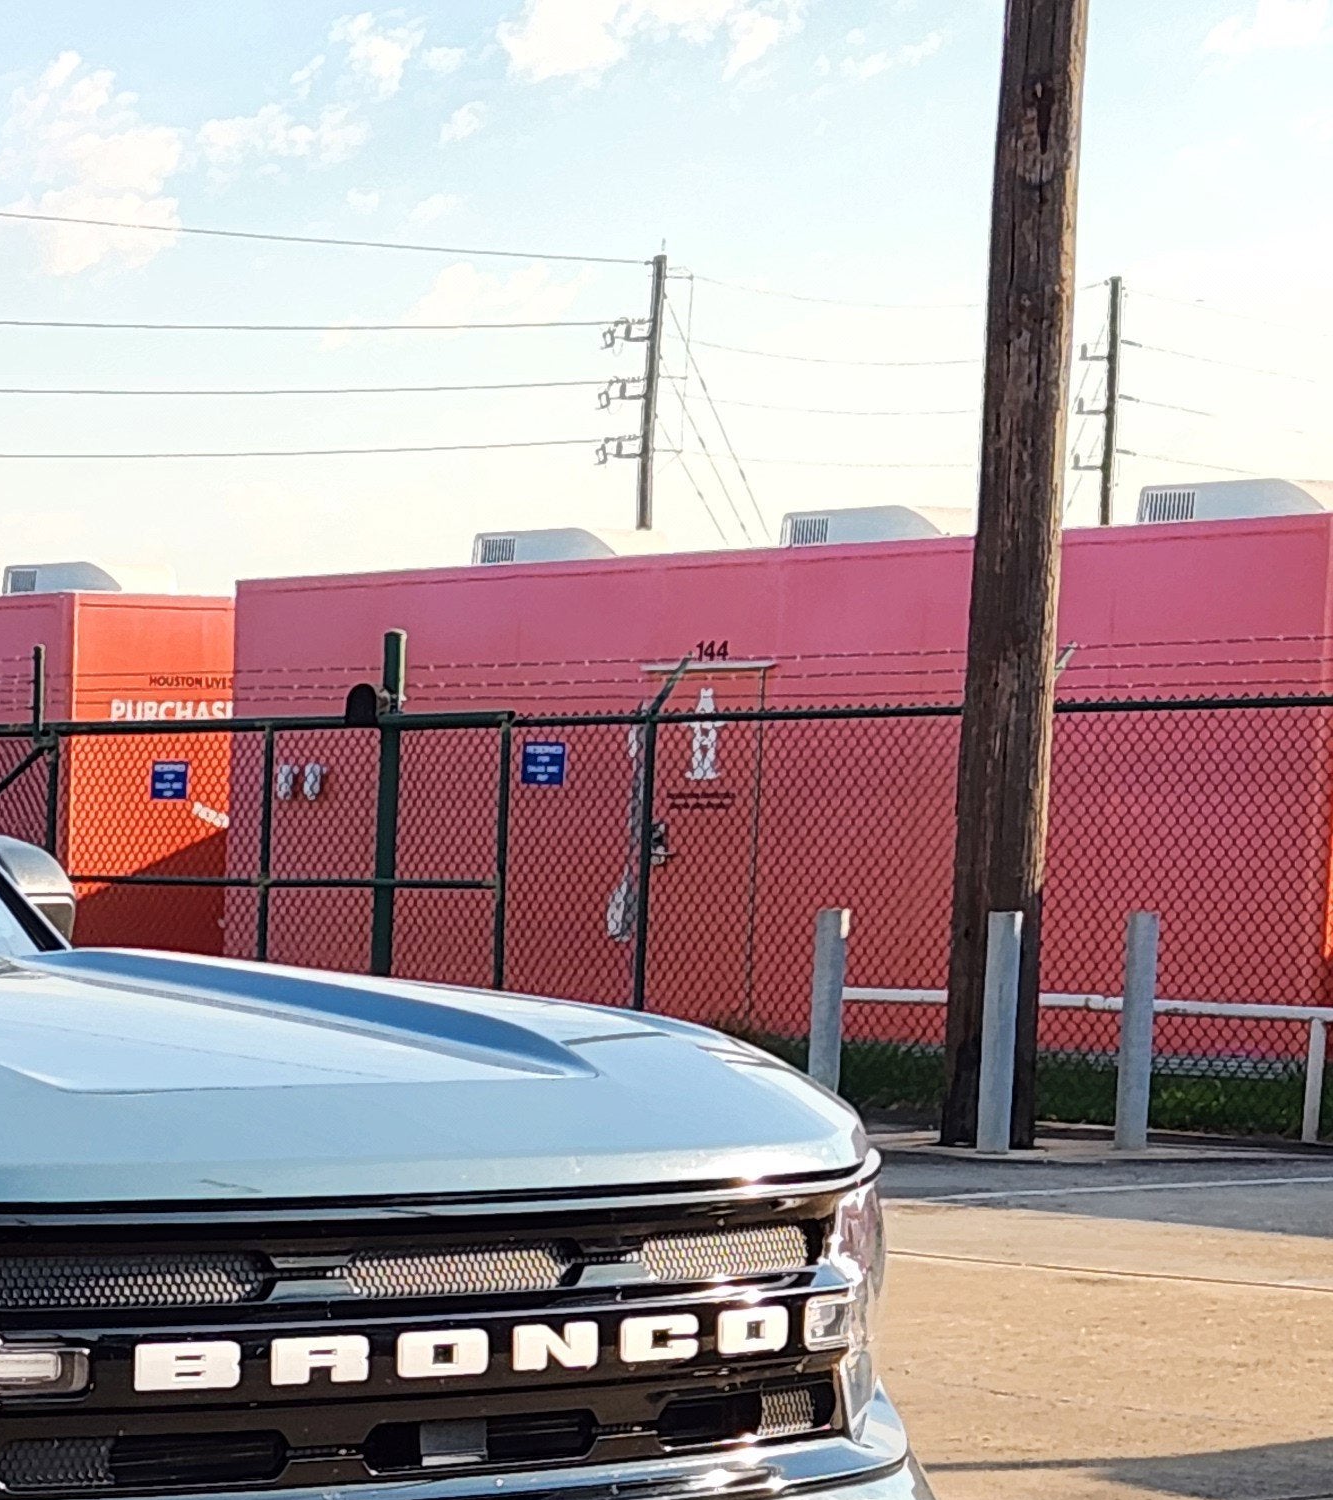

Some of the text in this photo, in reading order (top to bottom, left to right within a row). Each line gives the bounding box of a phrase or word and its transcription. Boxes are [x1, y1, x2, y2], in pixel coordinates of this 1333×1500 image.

[696, 640, 729, 661] 144
[149, 675, 202, 688] HOUSTON
[134, 1305, 789, 1392] BRONCO
